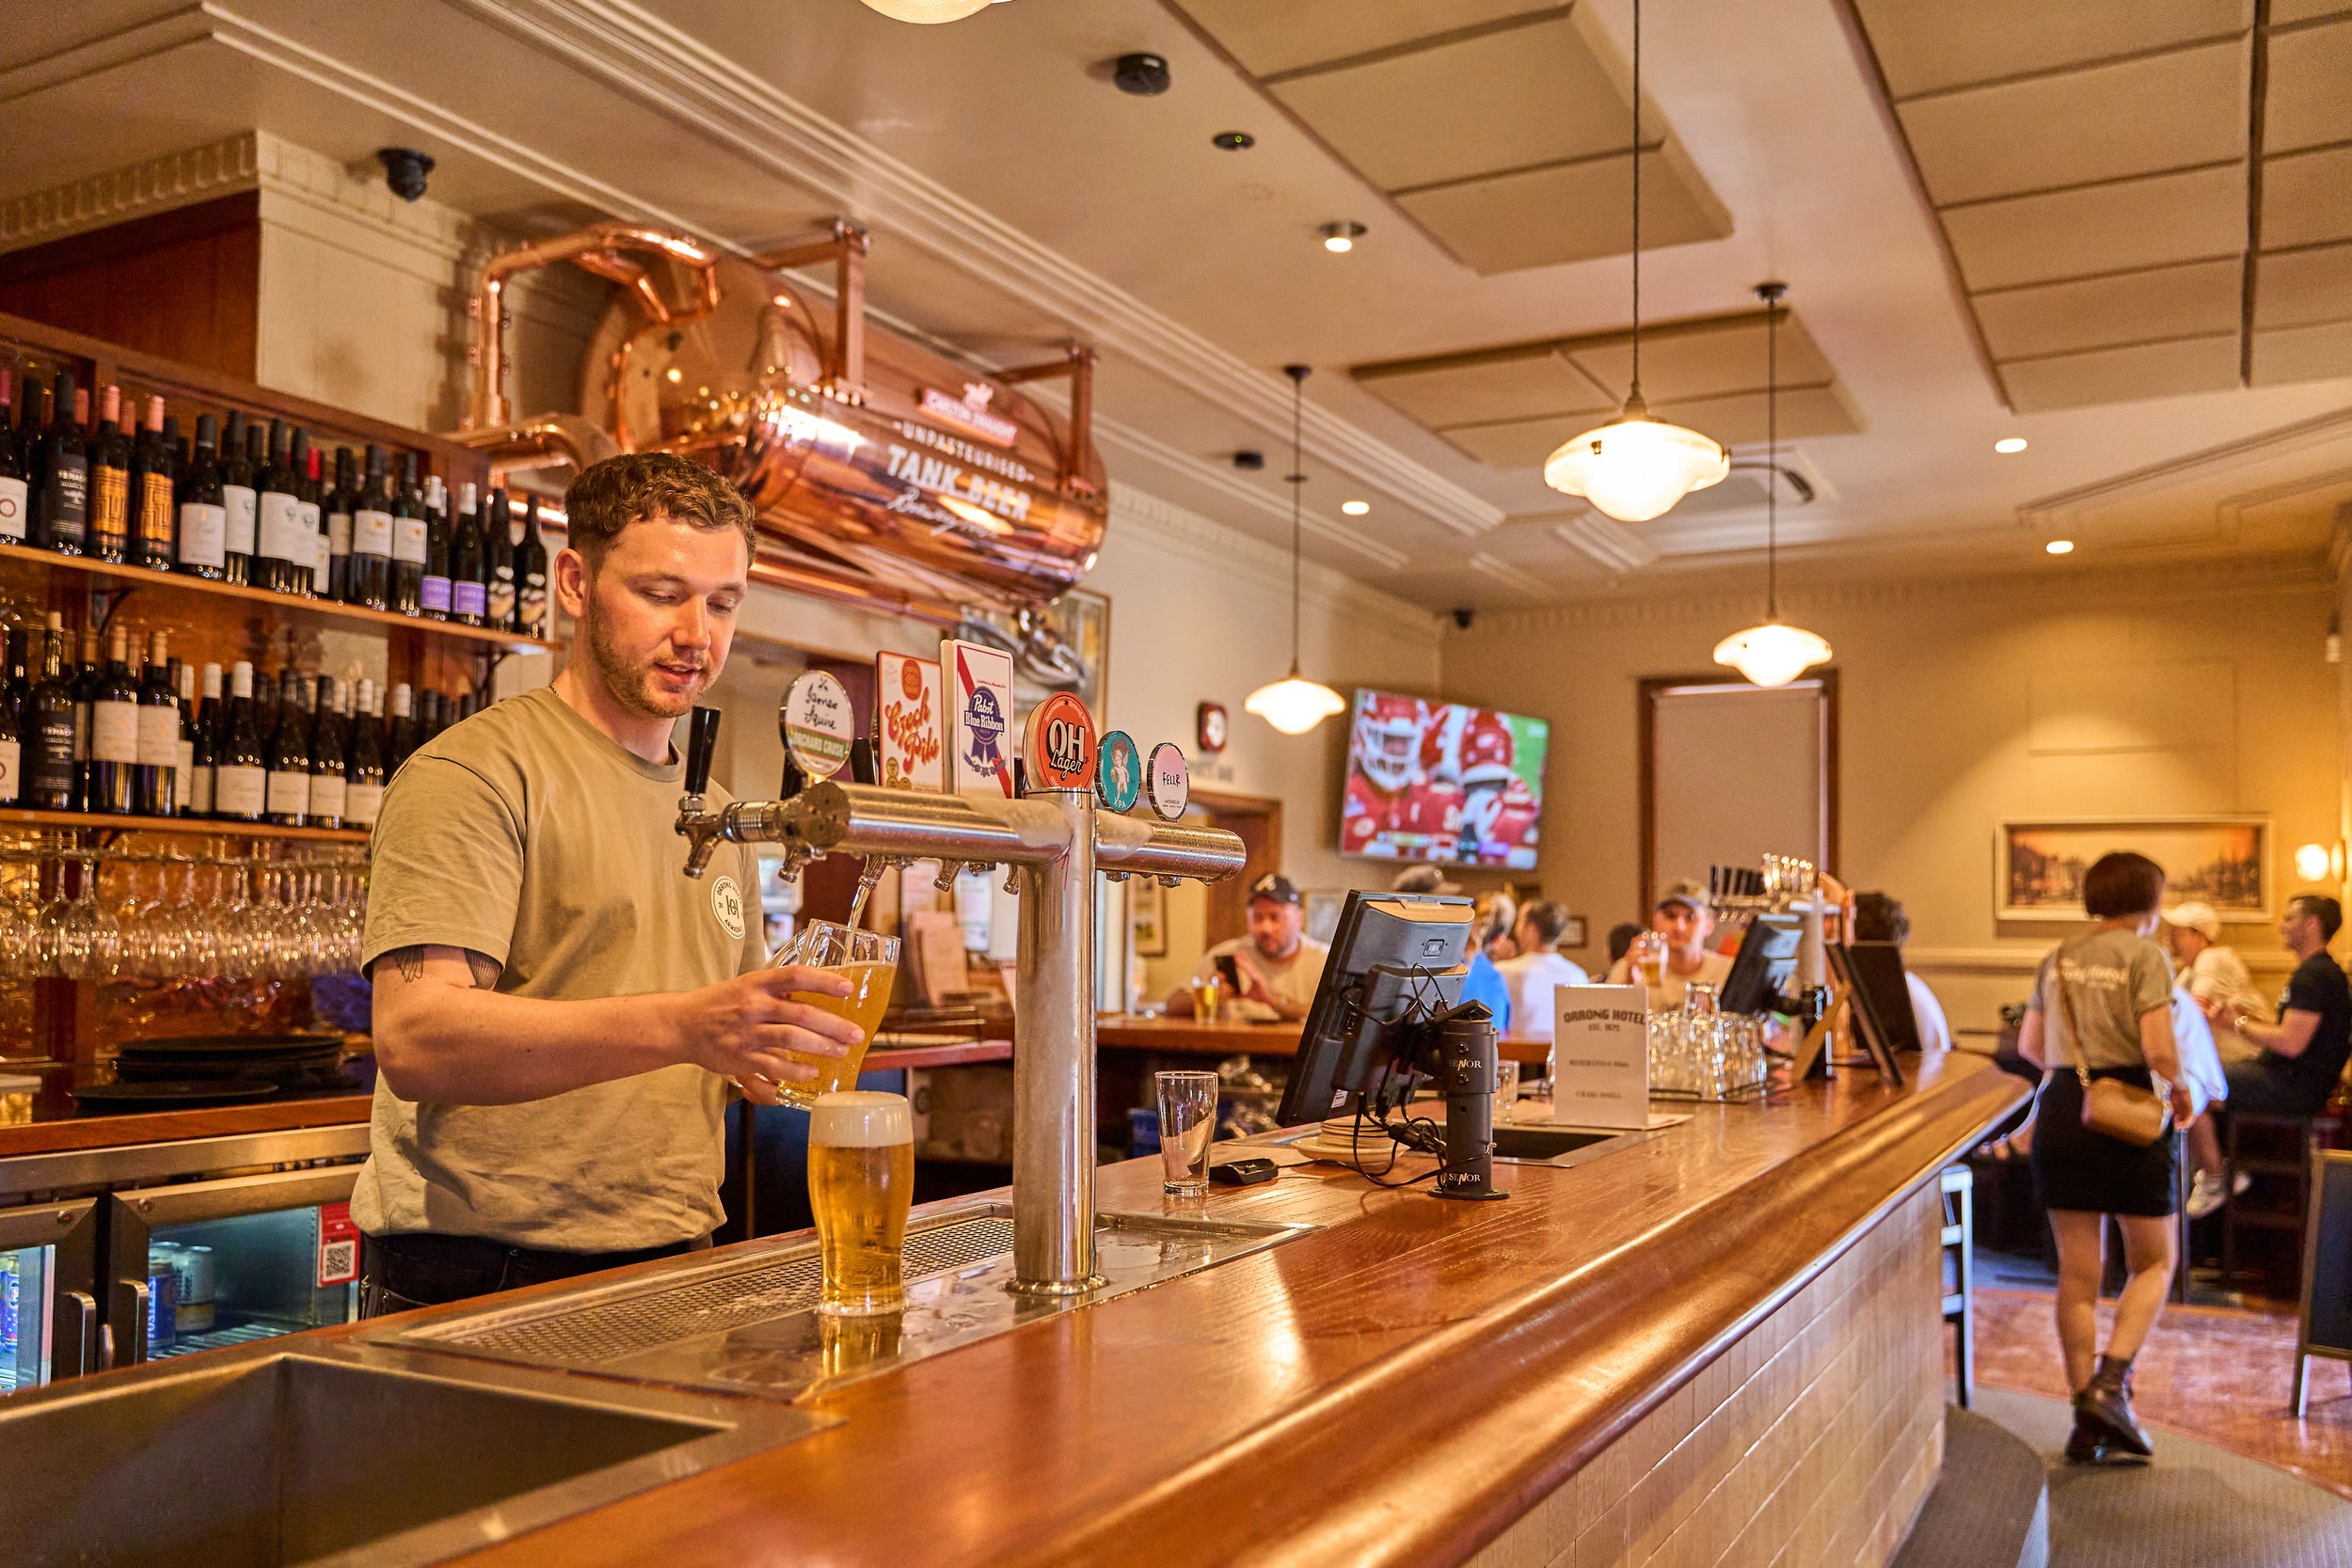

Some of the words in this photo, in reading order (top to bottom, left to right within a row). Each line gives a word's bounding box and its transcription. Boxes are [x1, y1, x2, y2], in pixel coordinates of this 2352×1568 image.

[887, 444, 961, 496] TANK
[968, 474, 1031, 521] BEER
[974, 694, 994, 715] Pabst
[884, 686, 930, 750] Czech
[965, 712, 980, 727] Blue
[980, 714, 1004, 732] Ribbon
[903, 726, 939, 775] Pils
[1049, 749, 1083, 781] Lager
[1564, 1008, 1610, 1023] ORRONG
[1612, 1009, 1645, 1026] HOTEL
[1449, 1172, 1482, 1186] SENOR
